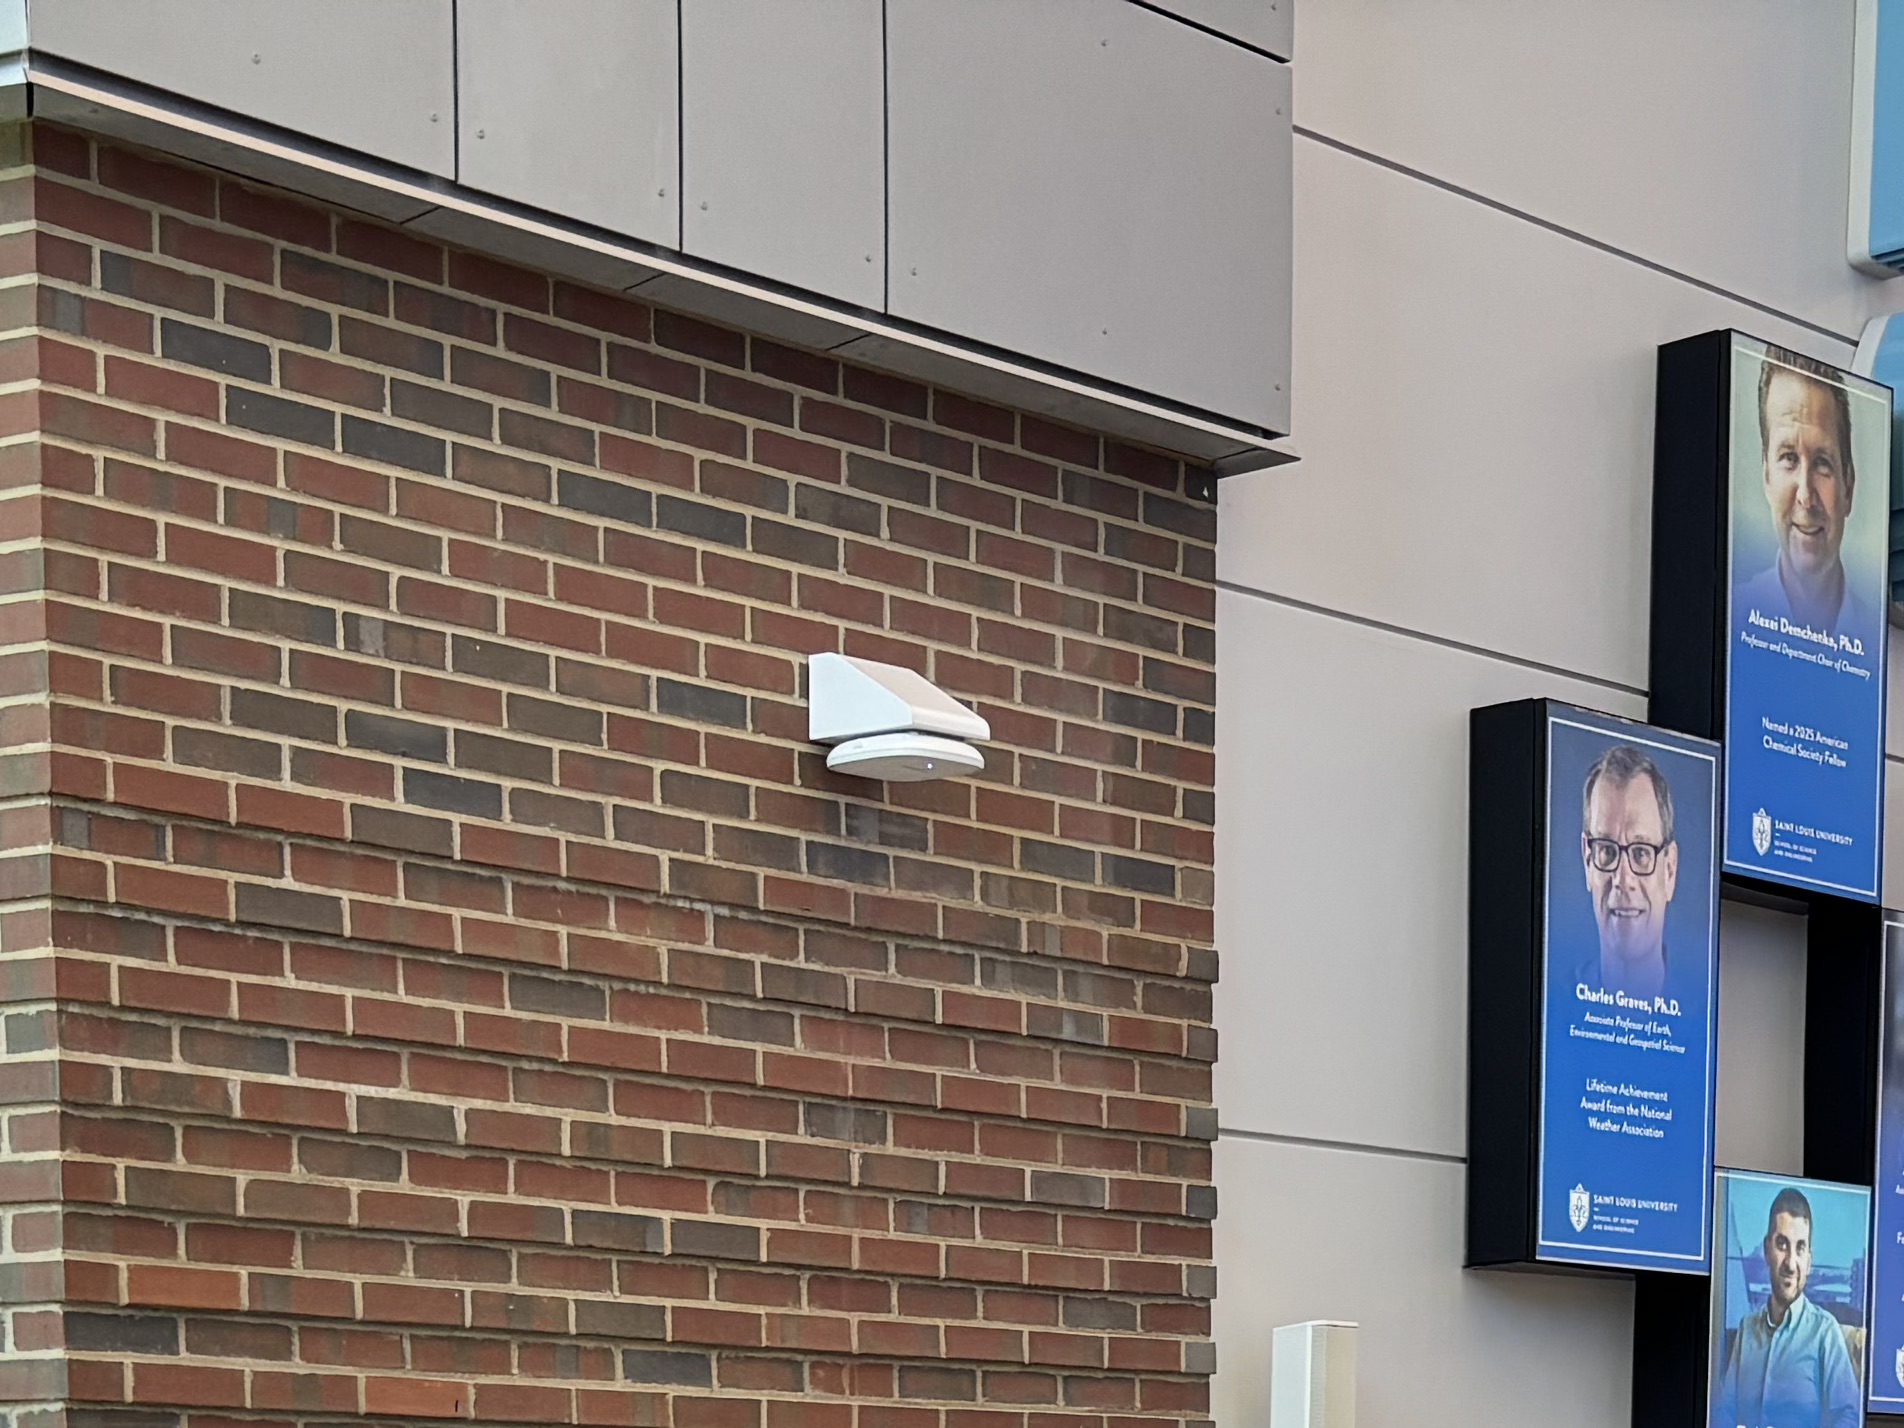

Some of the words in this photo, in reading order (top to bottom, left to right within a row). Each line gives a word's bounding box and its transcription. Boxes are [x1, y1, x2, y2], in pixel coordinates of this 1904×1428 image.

[1749, 609, 1778, 631] Alexei
[1840, 635, 1864, 655] Ph.D.
[1762, 717, 1788, 734] Named
[1795, 725, 1814, 741] 2025
[1815, 731, 1848, 750] American
[1763, 736, 1796, 756] Chemical
[1797, 745, 1823, 765] Society
[1816, 829, 1853, 845] UNIVERSITY
[1576, 983, 1614, 1005] Charles
[1616, 991, 1652, 1014] Graves,
[1654, 998, 1681, 1016] Ph.D.
[1586, 1079, 1618, 1096] Lifetime
[1619, 1084, 1668, 1102] Achievement
[1580, 1099, 1605, 1113] Award
[1607, 1101, 1625, 1114] from
[1626, 1104, 1639, 1117] the
[1641, 1106, 1672, 1121] National
[1589, 1117, 1620, 1133] Weather
[1622, 1121, 1664, 1138] Association
